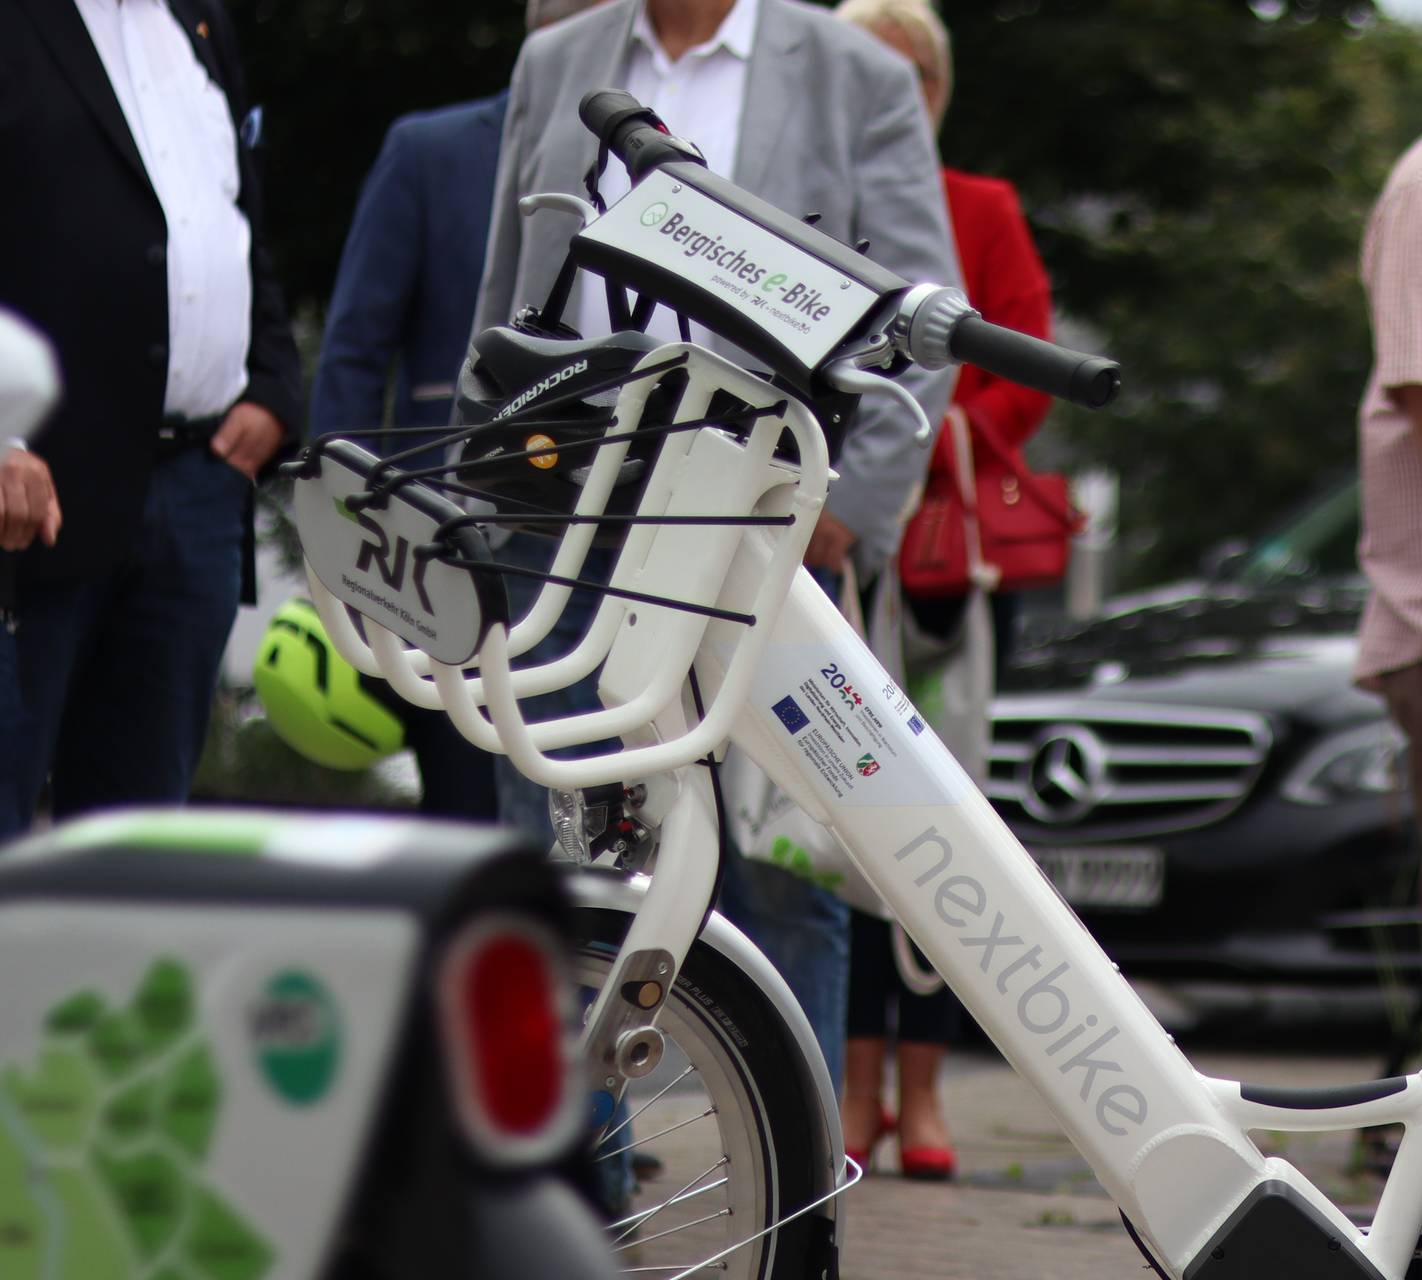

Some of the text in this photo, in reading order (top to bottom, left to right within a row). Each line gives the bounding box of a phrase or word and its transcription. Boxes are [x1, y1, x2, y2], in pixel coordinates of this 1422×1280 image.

[659, 213, 831, 322] Bergisches e-Bike
[710, 274, 742, 298] powered
[893, 825, 1148, 1136] nextbike
